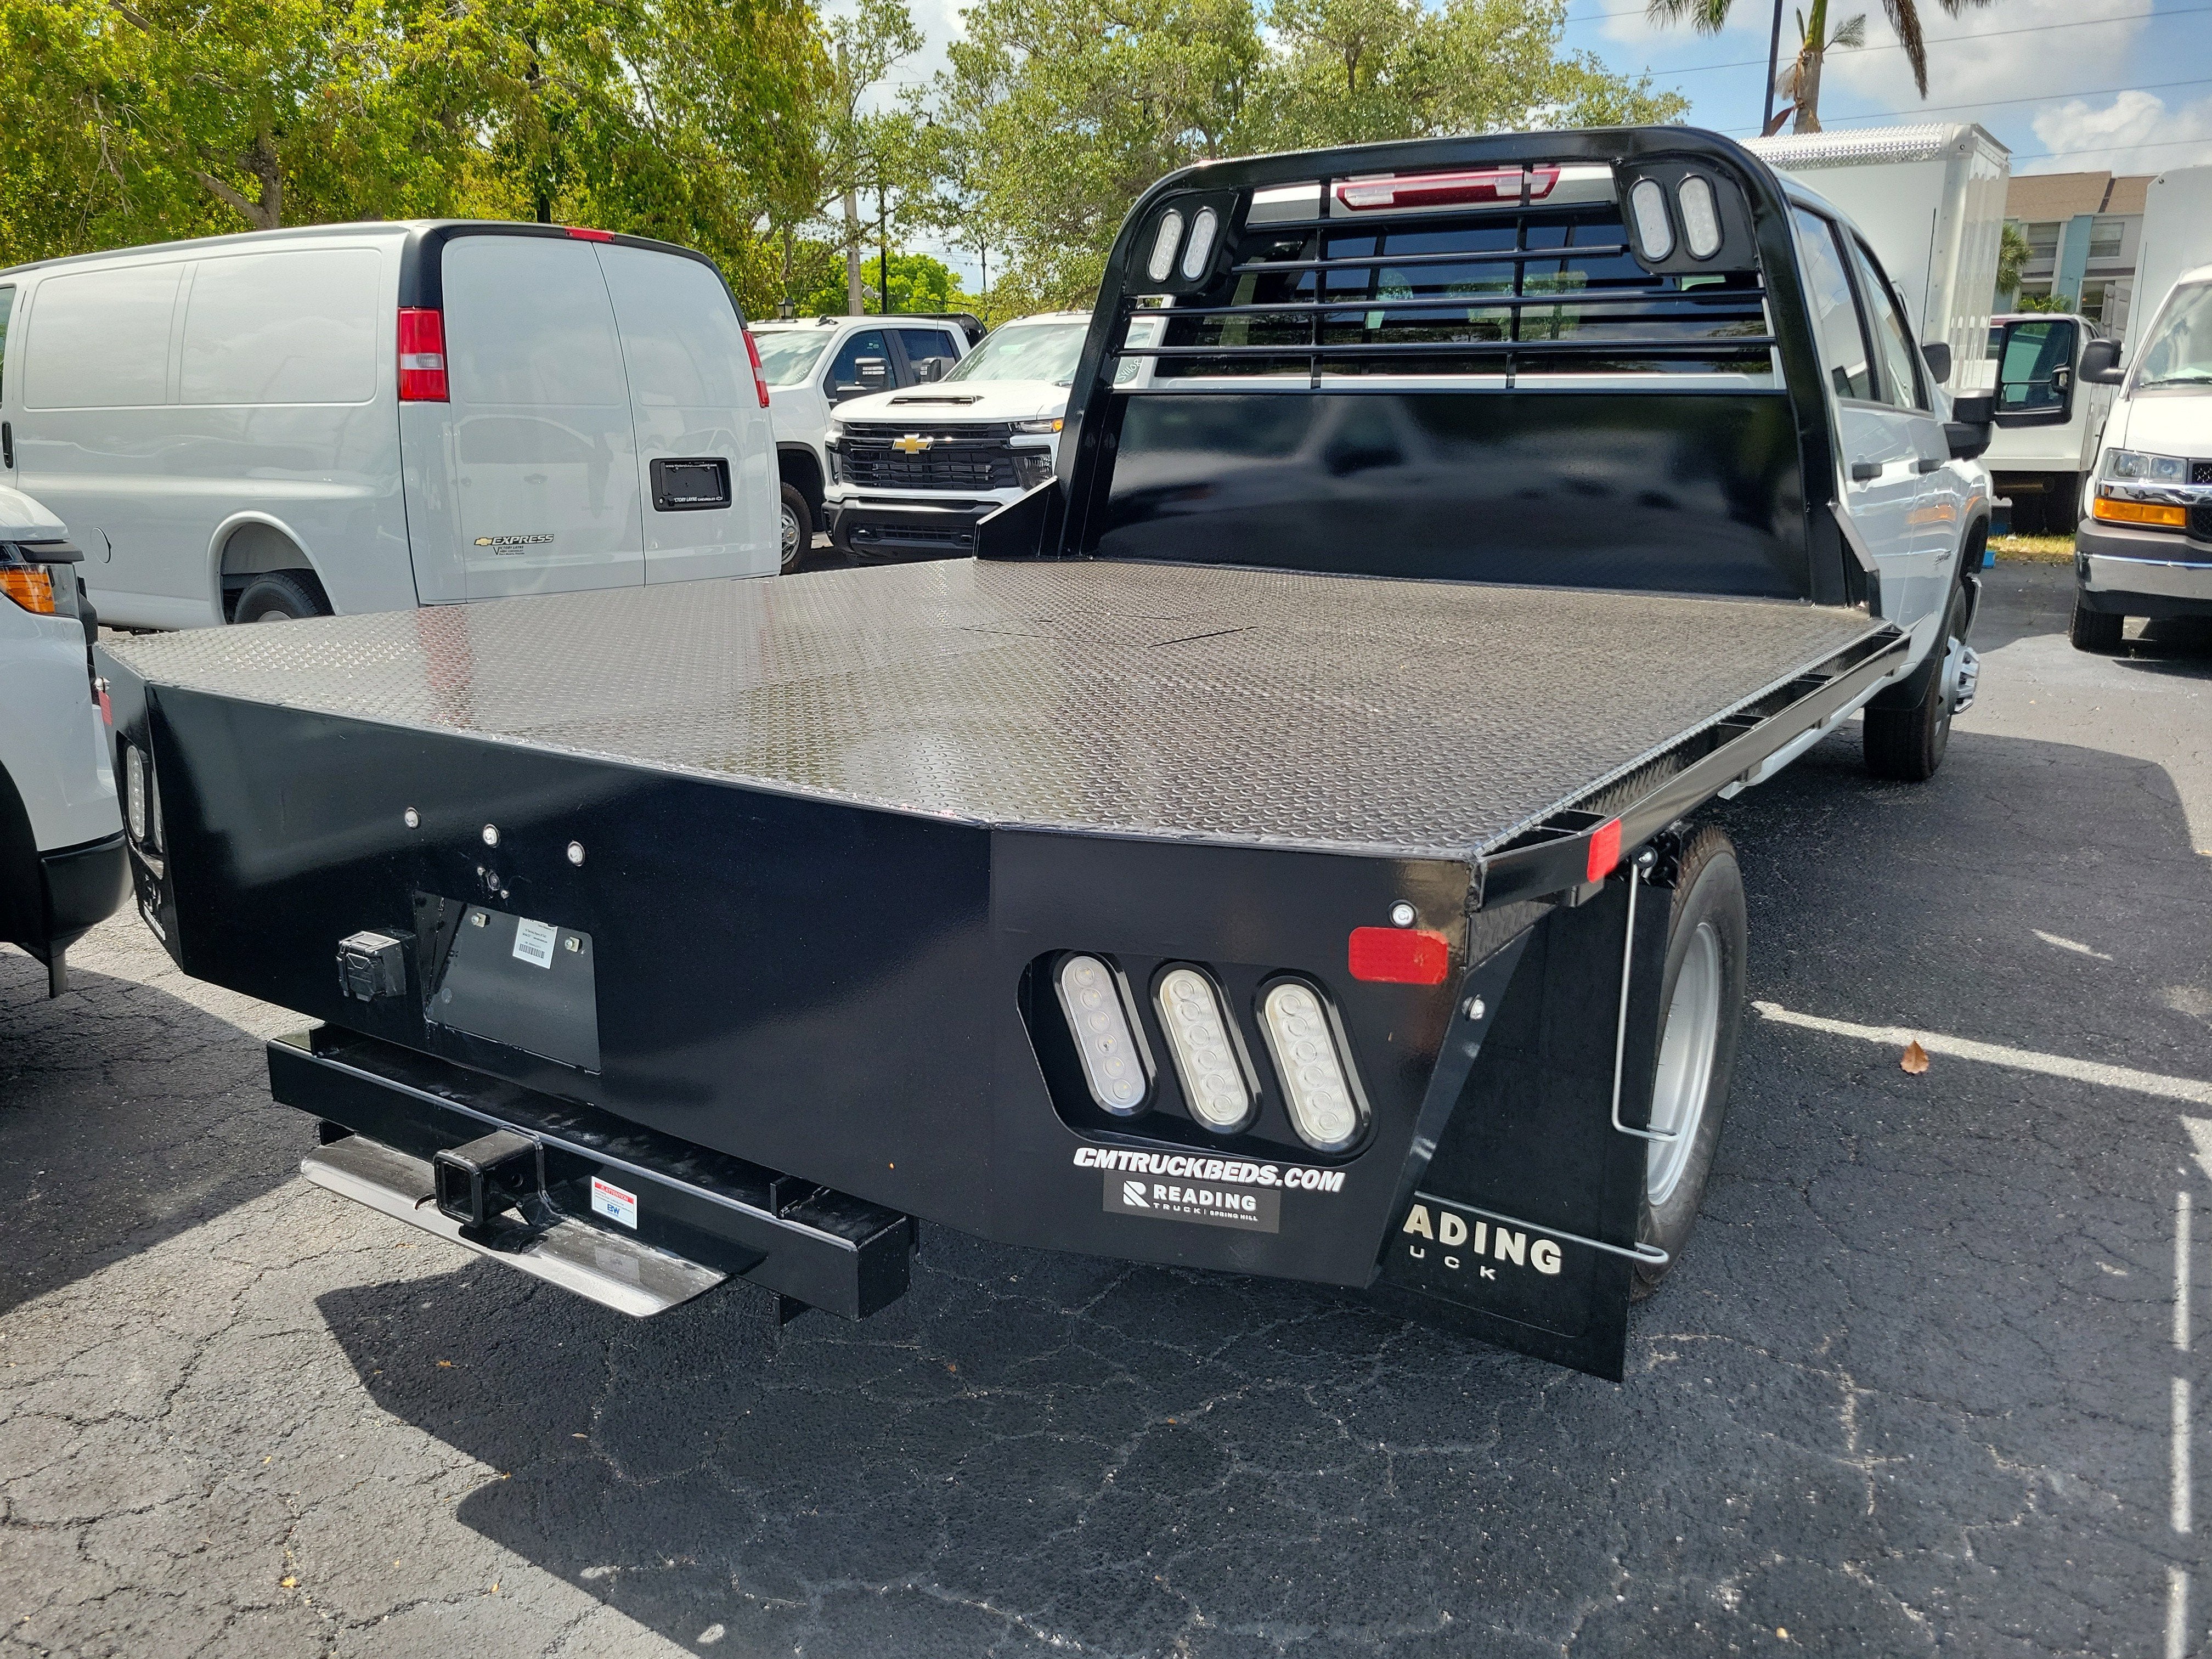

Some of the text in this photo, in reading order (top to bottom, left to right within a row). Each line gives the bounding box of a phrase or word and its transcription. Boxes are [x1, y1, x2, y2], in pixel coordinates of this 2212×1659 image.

[492, 534, 554, 545] EXPRESS
[1073, 1147, 1346, 1192] CMTRUCKBEDS.COM
[605, 1187, 628, 1201] ATTENTION
[1153, 1183, 1256, 1211] READING
[1153, 1202, 1259, 1222] TRUCK SPRING HILL
[1403, 1204, 1562, 1274] ADING
[1409, 1245, 1496, 1280] UCK
